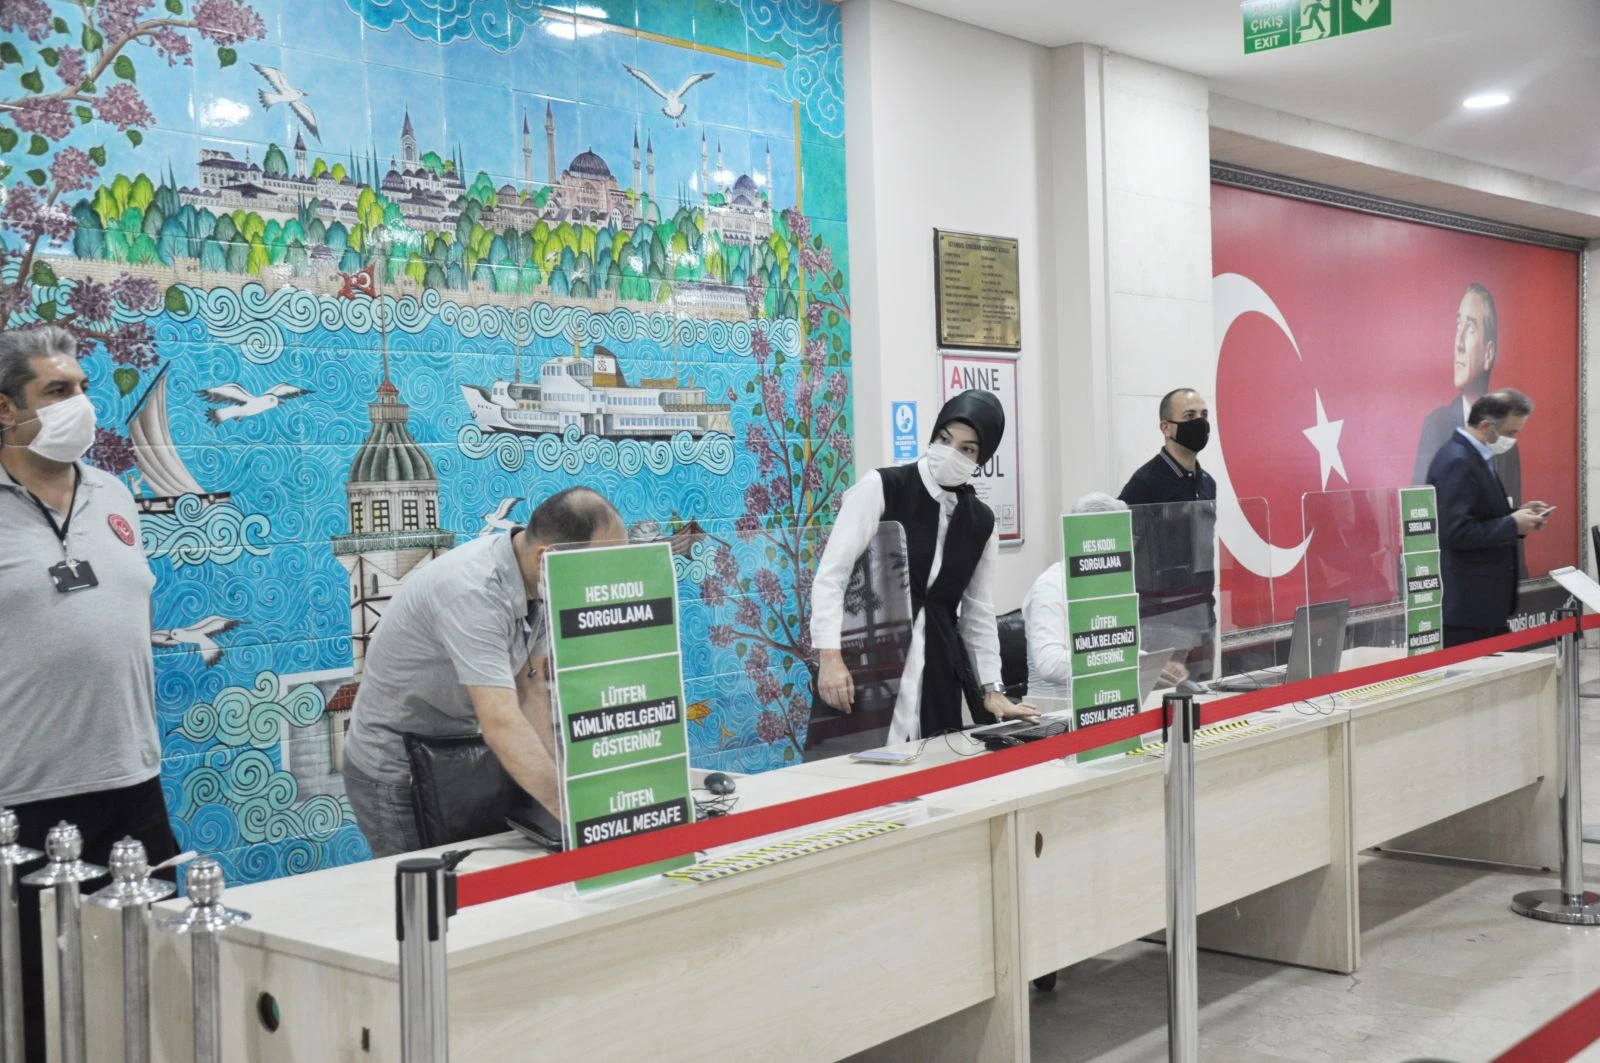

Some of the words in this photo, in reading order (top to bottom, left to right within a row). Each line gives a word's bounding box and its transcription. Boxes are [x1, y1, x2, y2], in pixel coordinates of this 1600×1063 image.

[1250, 15, 1283, 33] ÇIKIŞ
[1254, 35, 1280, 50] EXIT
[950, 366, 1000, 391] ANNE
[1083, 539, 1097, 552] HES
[1097, 538, 1116, 551] KODU
[1079, 555, 1122, 571] SORGULAMA
[585, 582, 609, 604] HES
[611, 581, 643, 600] KODU
[578, 604, 654, 629] SORGULAMA
[1091, 614, 1117, 631] LÜTFEN
[1075, 633, 1098, 651] KİMLİK
[1098, 628, 1135, 648] BELGENİZİ
[1087, 649, 1125, 667] GÖSTERİNİZ
[601, 685, 646, 707] LÜTFEN
[1095, 689, 1121, 706] LÜTFEN
[573, 713, 615, 738] KİMLİK
[616, 700, 676, 727] BELGENİZİ
[1080, 709, 1106, 727] SOSYAL
[1107, 705, 1135, 721] MESAFE
[592, 728, 662, 758] GÖSTERİNİZ
[610, 787, 654, 813] LÜTFEN
[583, 817, 631, 844] SOSYAL
[633, 805, 681, 831] MESAFE
